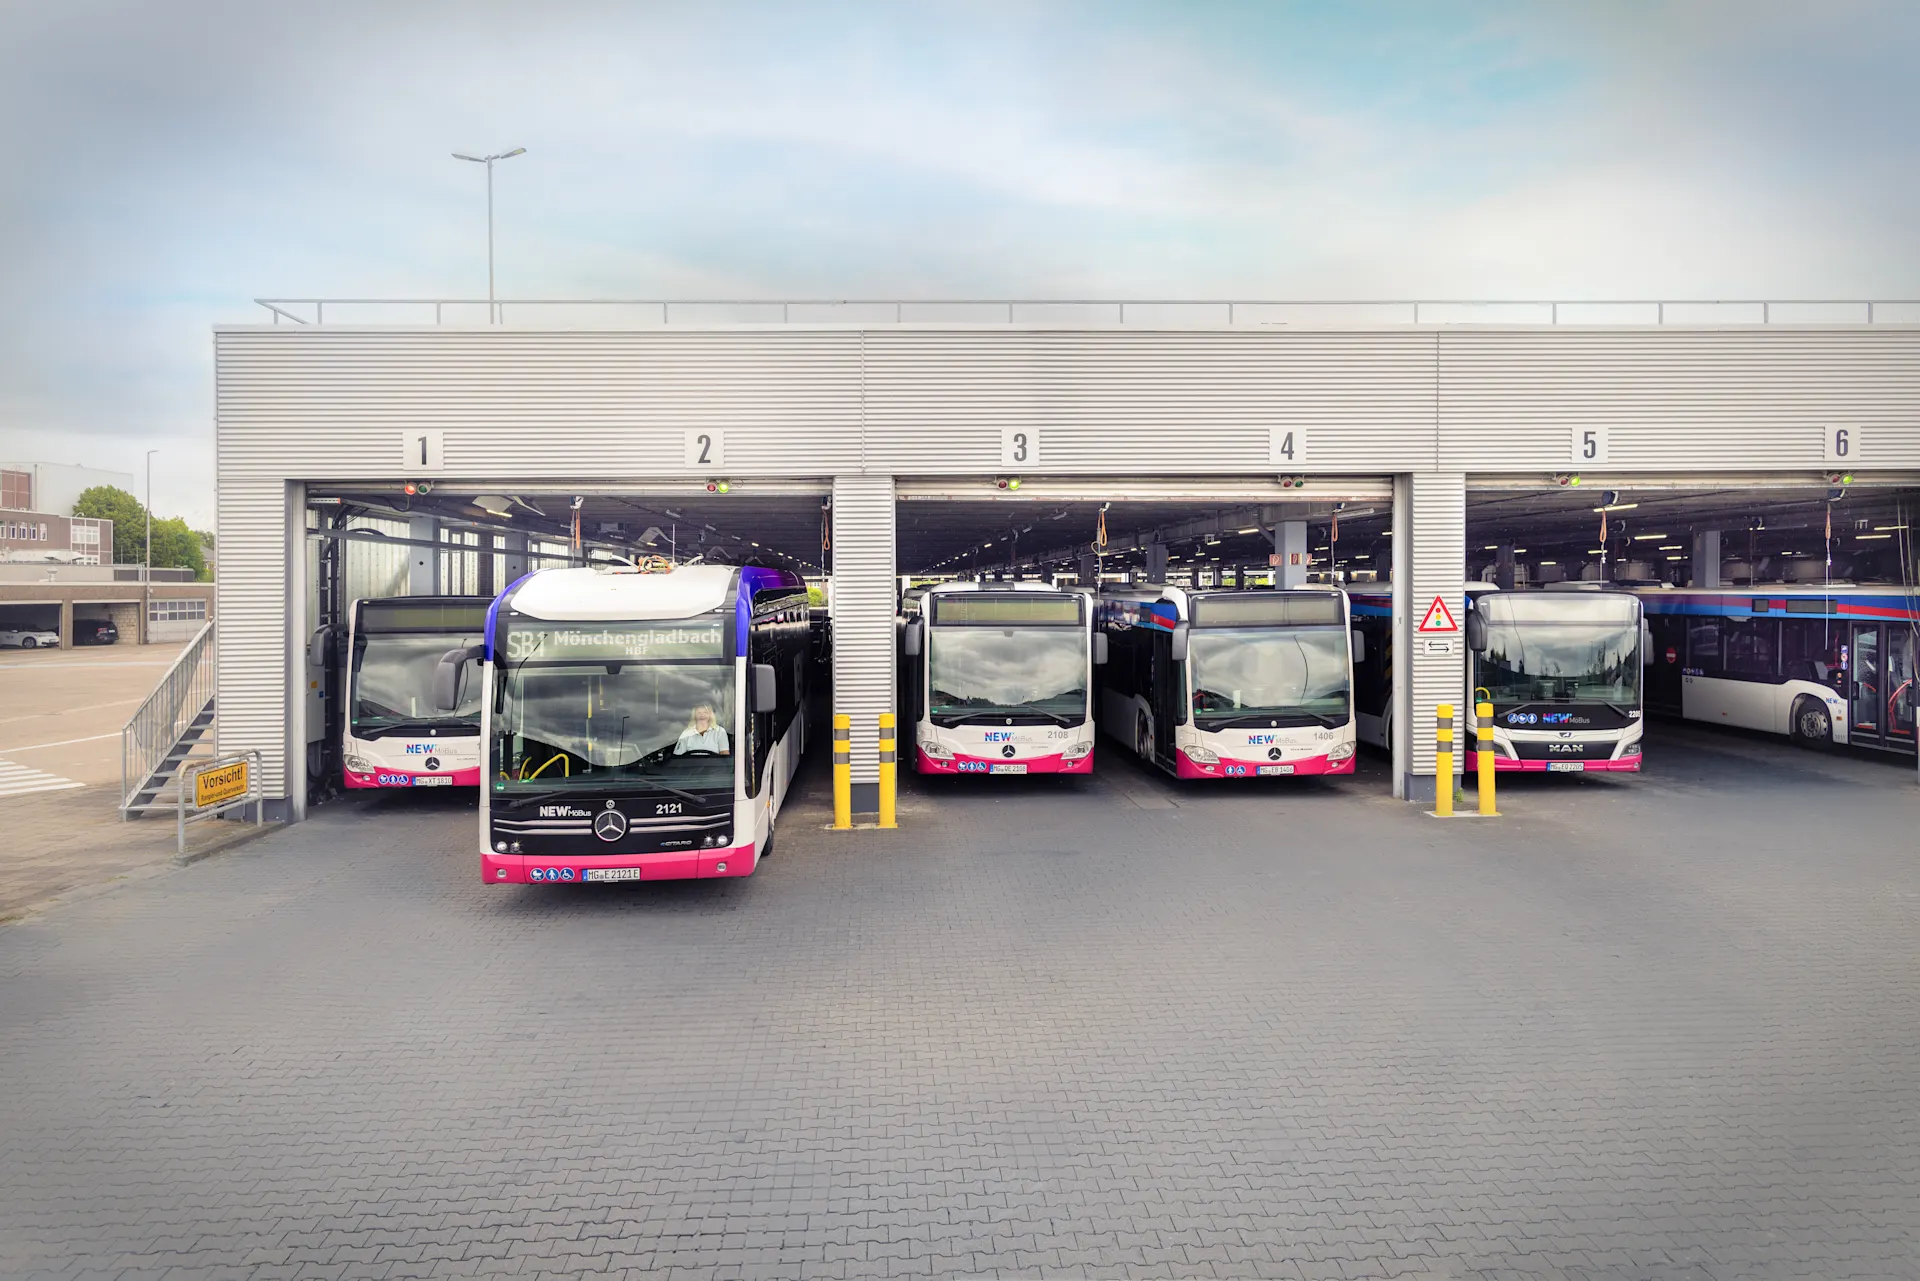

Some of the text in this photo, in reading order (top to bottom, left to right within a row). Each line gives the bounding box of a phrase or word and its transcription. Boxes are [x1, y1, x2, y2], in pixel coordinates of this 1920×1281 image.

[697, 434, 712, 464] 2
[1013, 433, 1027, 462] 3
[1280, 432, 1295, 460] 4
[1583, 431, 1596, 459] 5
[1836, 429, 1849, 457] 6
[418, 436, 427, 466] 1
[507, 629, 722, 658] SB1 Mönchengladbach
[625, 646, 648, 655] HBF
[1542, 713, 1570, 724] NEW
[985, 732, 1012, 742] NEW
[1047, 731, 1069, 739] 2108
[1248, 735, 1275, 744] NEW
[1314, 732, 1334, 740] 1406
[406, 744, 435, 754] NEW
[1549, 744, 1584, 752] MAN
[203, 766, 243, 790] Vorsicht!
[539, 805, 592, 817] NEW MöBus
[656, 803, 682, 815] 2121
[588, 870, 600, 880] MG
